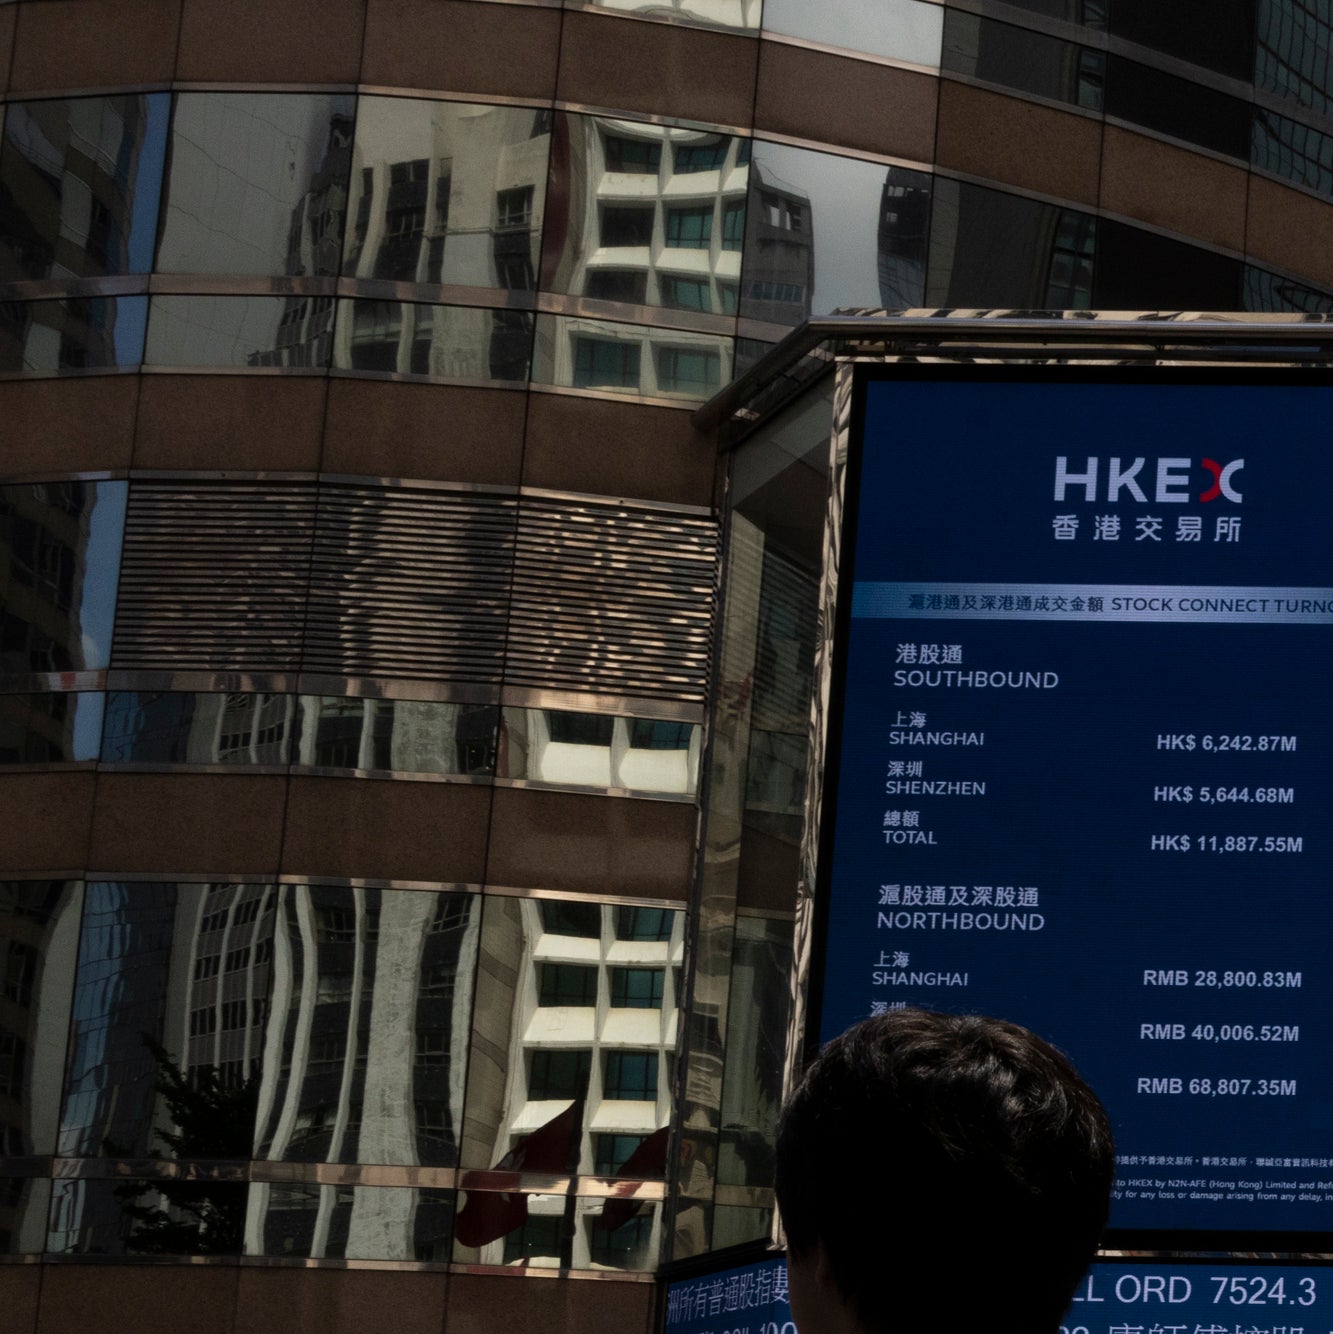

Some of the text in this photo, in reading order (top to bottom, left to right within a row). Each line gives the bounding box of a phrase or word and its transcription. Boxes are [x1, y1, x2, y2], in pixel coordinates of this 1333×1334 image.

[1054, 456, 1246, 503] HKEX
[1053, 515, 1241, 542] 香港交易所
[1112, 598, 1173, 611] STOCK
[1178, 599, 1270, 612] CONNECT
[896, 643, 962, 664] 港股通
[894, 670, 1058, 688] SOUTHBOUND
[891, 711, 926, 728] 上海
[890, 732, 984, 745] SHANGHAI
[1157, 734, 1296, 752] HK$ 6,242.87M
[887, 761, 922, 777] 深圳
[886, 781, 985, 795] SHENZHEN
[1155, 786, 1294, 804] HK$ 5,644.68M
[883, 810, 919, 827] 總額
[883, 831, 937, 844] TOTAL
[1152, 835, 1302, 853] HK$ 11,887.55M
[878, 885, 1038, 907] 滬股通及深股通
[878, 912, 1044, 930] NORTHBOUND
[874, 951, 909, 968] 上海
[873, 972, 968, 986] SHANGHAI
[1144, 970, 1301, 989] RMB 28,800.83M
[1141, 1024, 1299, 1042] RMB 40,006.52M
[1138, 1078, 1296, 1096] RMB 68,807.35M
[1129, 1179, 1152, 1188] HKEX
[1116, 1275, 1191, 1303] ORD
[1211, 1277, 1316, 1305] 7524.3
